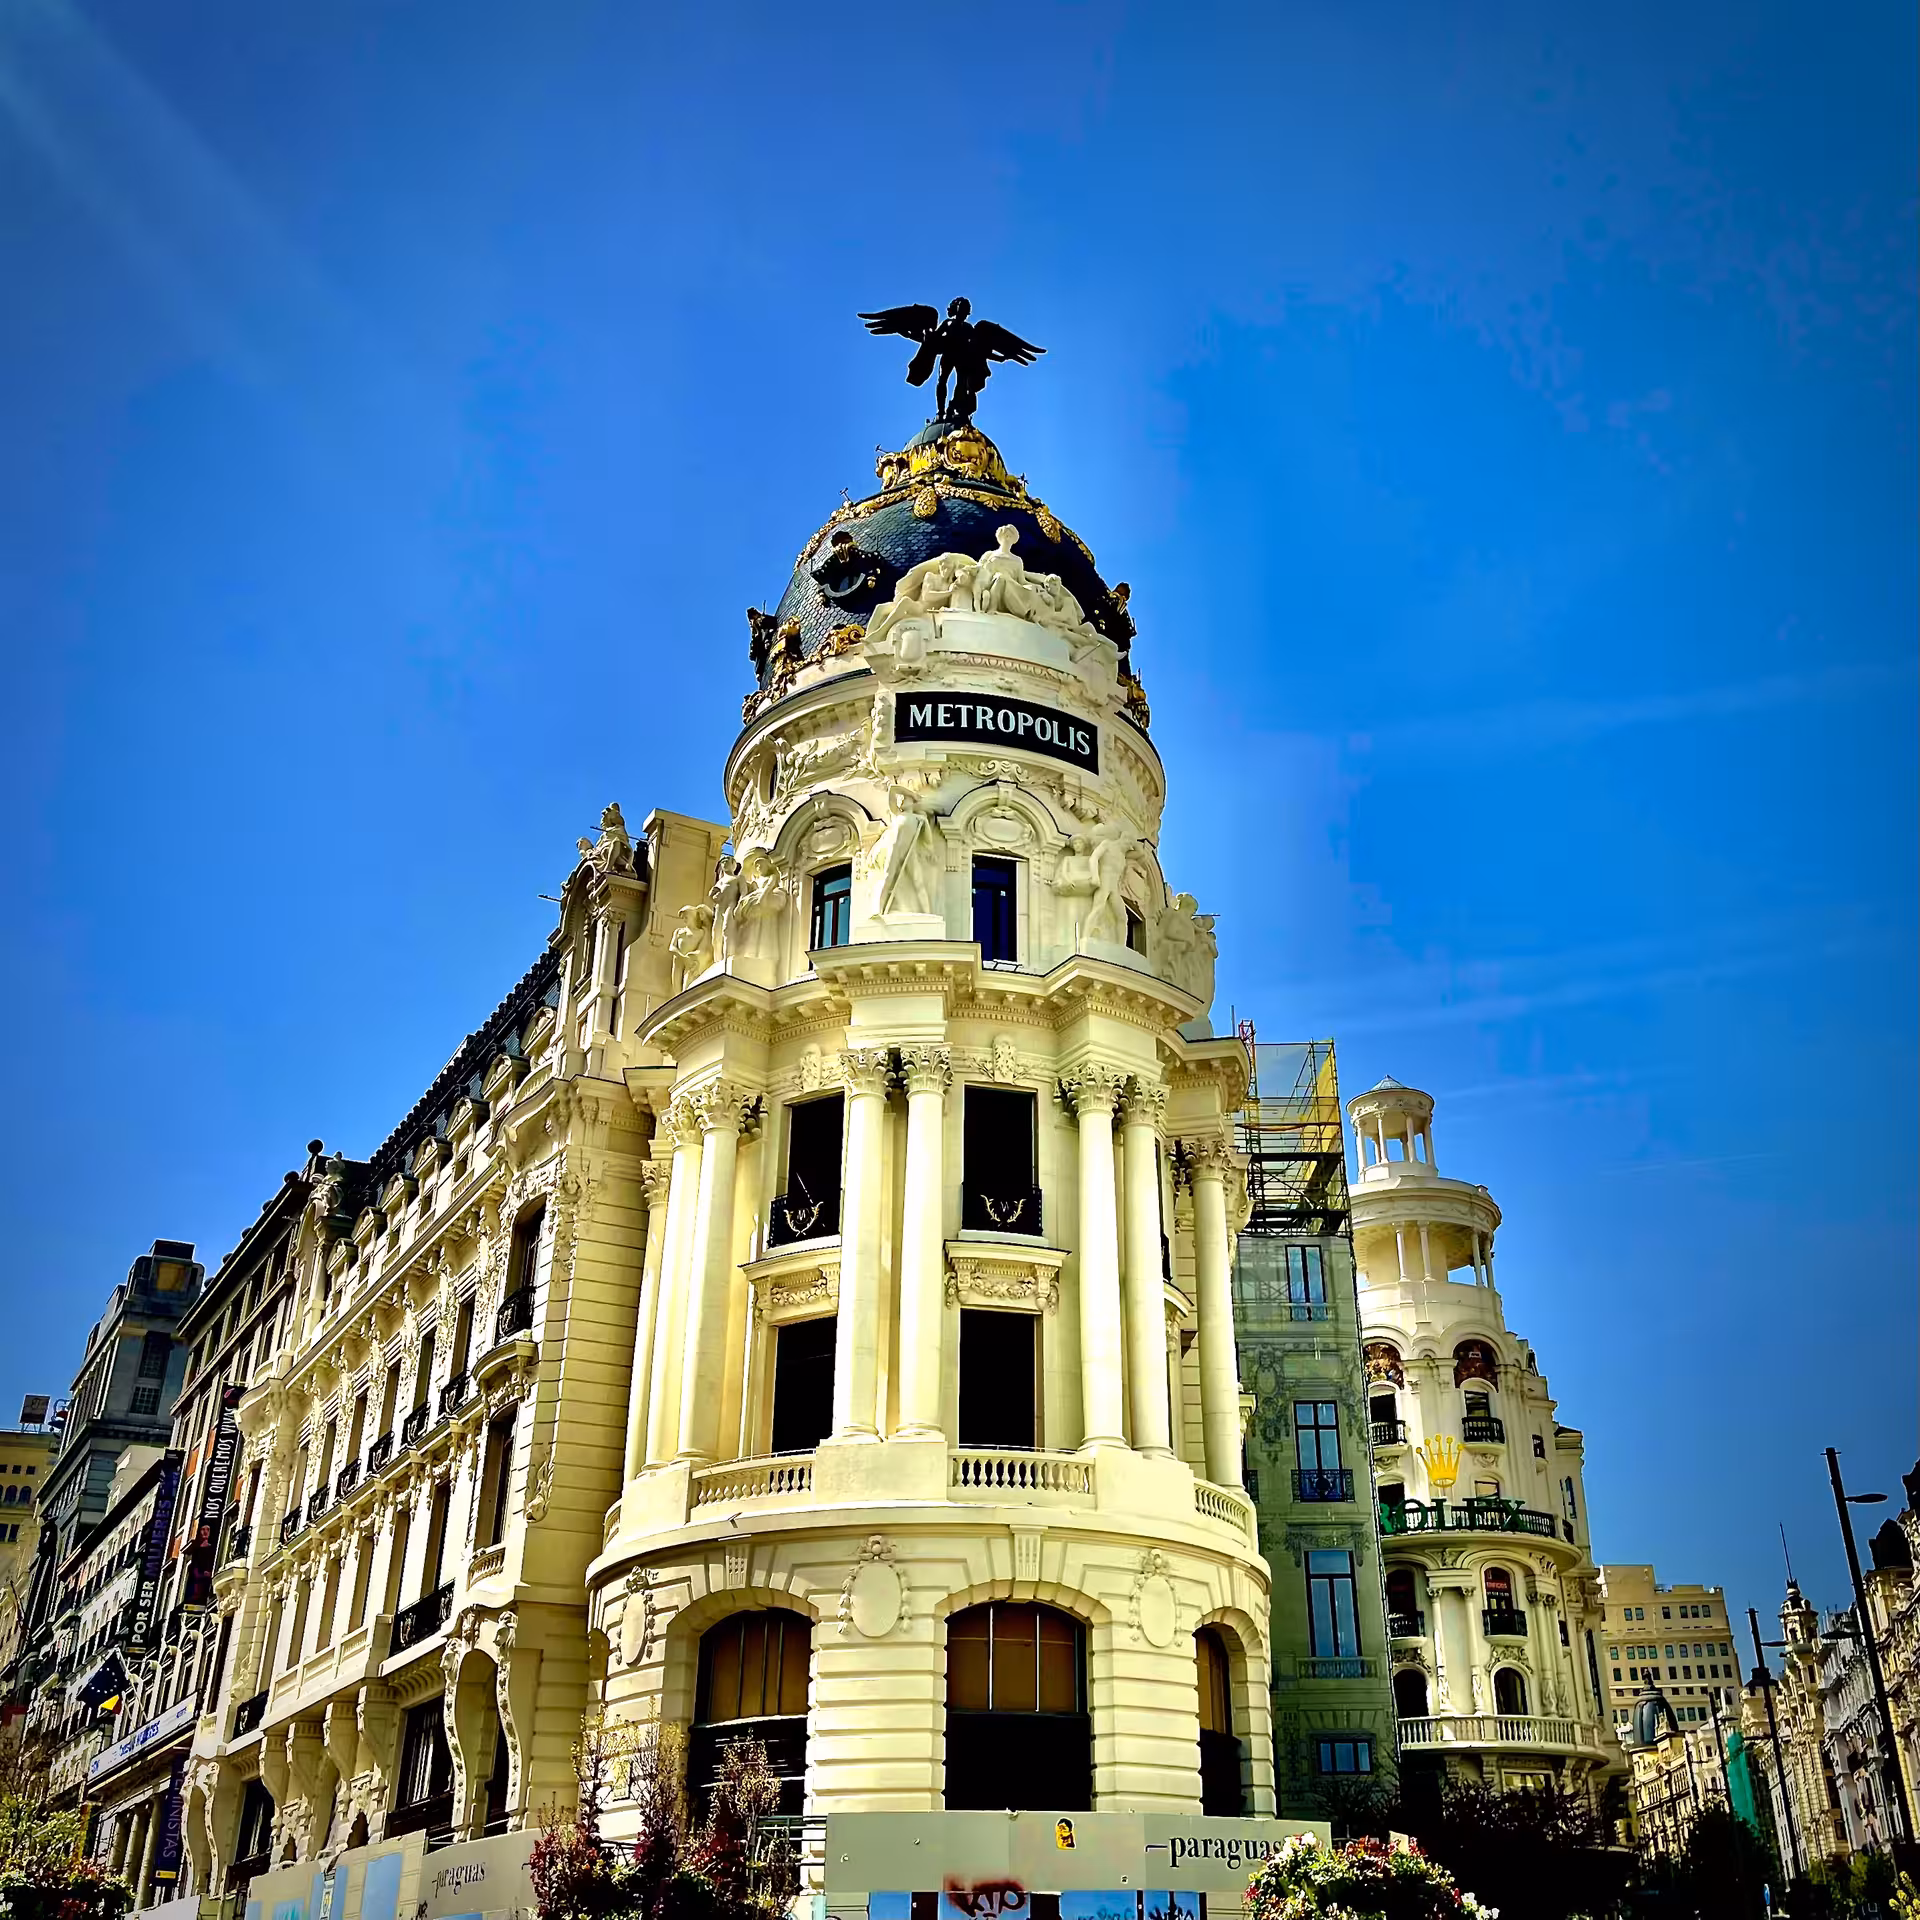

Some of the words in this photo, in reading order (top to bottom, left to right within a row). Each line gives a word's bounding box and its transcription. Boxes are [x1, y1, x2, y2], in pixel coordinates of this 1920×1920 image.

[909, 703, 1091, 756] METROPOLIS
[220, 1406, 238, 1435] VIVAS
[209, 1438, 235, 1494] QUEREMOS
[204, 1497, 223, 1519] NOS
[144, 1499, 173, 1578] MUJERES
[139, 1581, 156, 1608] SER
[131, 1611, 150, 1644] POR
[1169, 1836, 1282, 1870] paraguas
